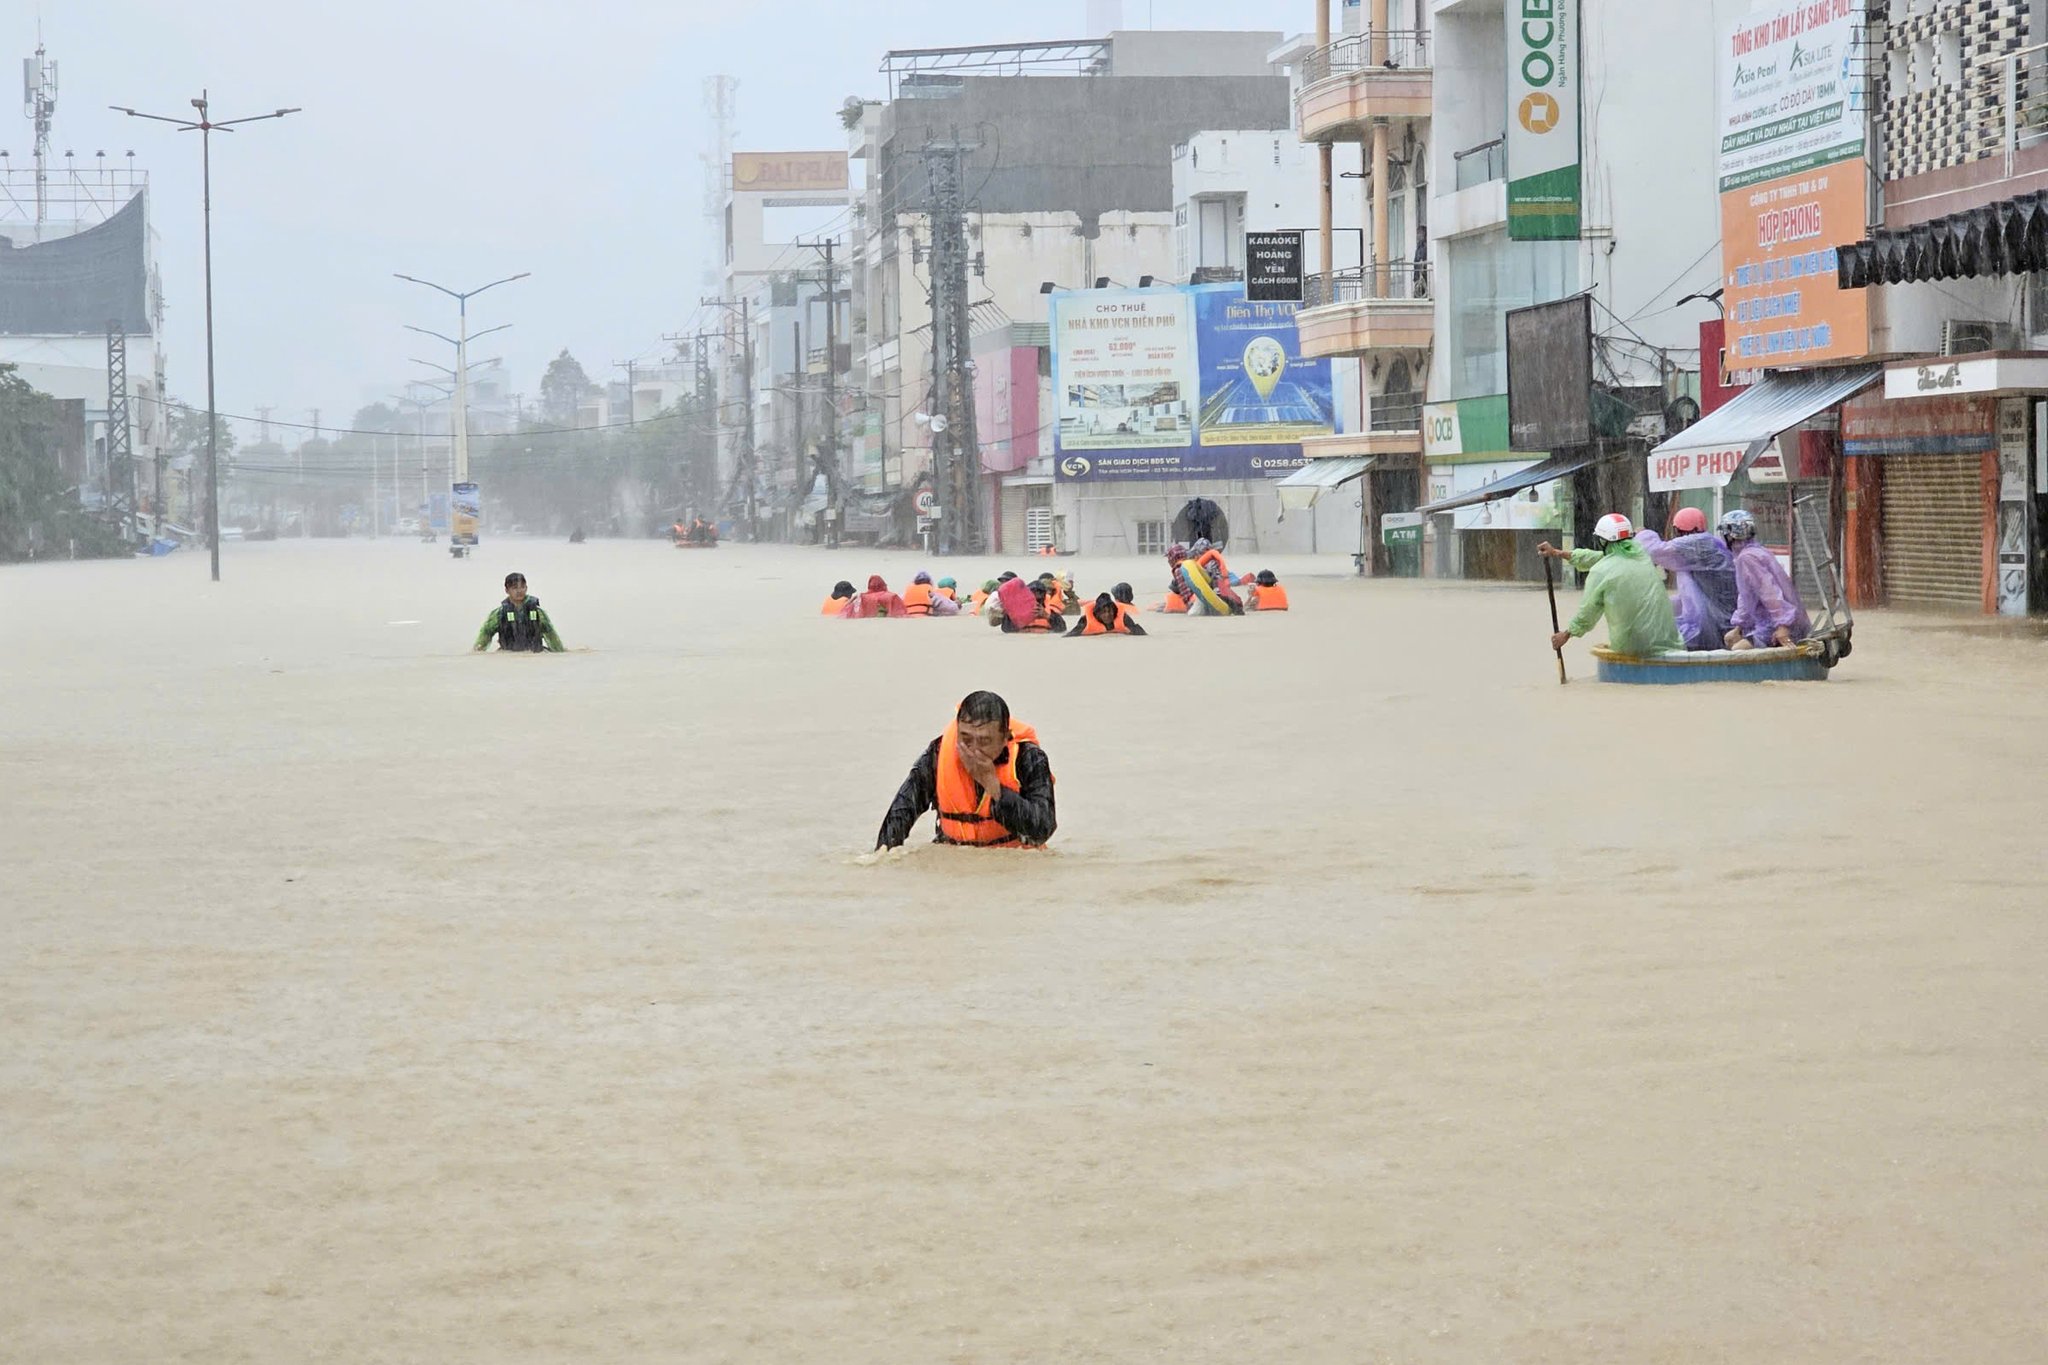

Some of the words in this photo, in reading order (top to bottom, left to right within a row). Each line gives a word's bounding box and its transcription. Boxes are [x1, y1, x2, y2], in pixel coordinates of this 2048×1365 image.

[1558, 12, 1567, 42] Phương
[1732, 24, 1752, 57] TỔNG
[1754, 24, 1769, 49] KHO
[1772, 8, 1788, 43] TẤM
[1791, 5, 1806, 37] LẤY
[1808, 0, 1829, 31] SÁNG
[1558, 44, 1567, 65] Hàng
[1816, 44, 1834, 63] LITE
[1558, 66, 1568, 88] Ngân
[1733, 62, 1758, 87] Asia
[1757, 61, 1777, 79] Pearl
[1780, 92, 1789, 111] CÓ
[1816, 81, 1836, 98] 18MM
[1755, 127, 1764, 140] VÀ
[1764, 123, 1778, 137] DUY
[1778, 118, 1798, 134] NHẤT
[1798, 115, 1810, 131] TẠI
[1810, 110, 1825, 126] VIỆT
[1825, 106, 1842, 120] NAM
[1750, 191, 1768, 206] CÔNG
[1770, 189, 1780, 201] TY
[1780, 184, 1798, 199] TNHH
[1811, 180, 1817, 192] &
[1818, 176, 1828, 191] DV
[1758, 208, 1781, 250] HỢP
[1782, 201, 1821, 242] PHONG
[1248, 237, 1299, 245] KARAOKE
[1256, 248, 1292, 259] HOÀNG
[1265, 261, 1285, 273] YẾN
[1251, 275, 1275, 284] CÁCH
[1096, 305, 1117, 313] CHO
[1122, 302, 1147, 312] THUÊ
[1255, 303, 1275, 320] Thọ
[1068, 316, 1088, 330] NHÀ
[1090, 318, 1109, 329] KHO
[1111, 317, 1130, 329] VCN
[1435, 416, 1453, 441] OCB
[1098, 457, 1112, 466] SÀN
[1132, 458, 1149, 467] DỊCH
[1165, 457, 1180, 465] VCN
[1656, 454, 1690, 482] HỢP
[920, 496, 932, 507] 40
[1392, 530, 1416, 540] ATM
